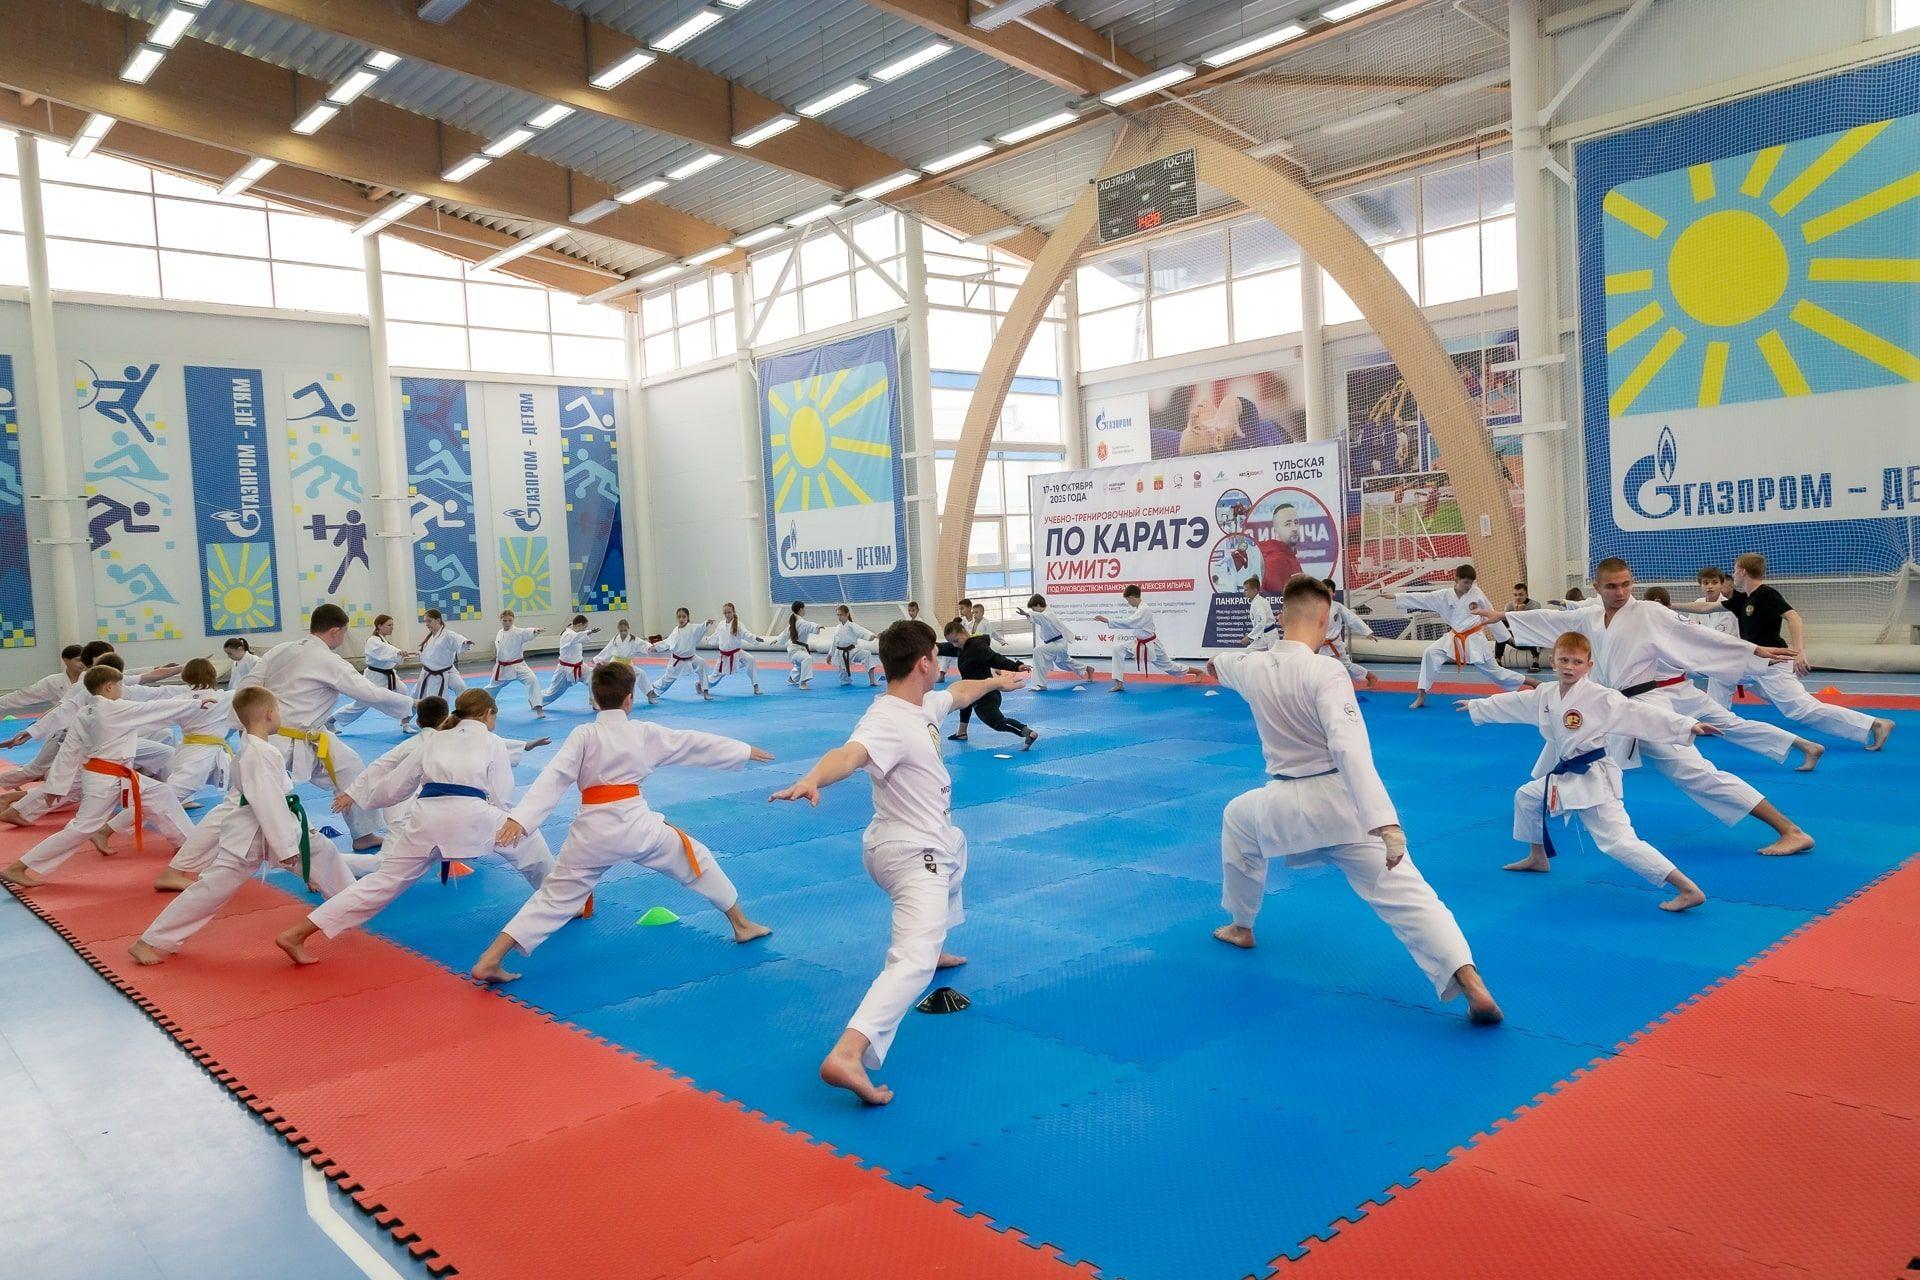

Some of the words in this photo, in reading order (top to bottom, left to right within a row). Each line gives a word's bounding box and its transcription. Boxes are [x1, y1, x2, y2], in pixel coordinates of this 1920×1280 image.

[1163, 152, 1193, 170] ГОСТИ
[1099, 171, 1136, 191] ХОЗЯЕВА
[232, 378, 257, 426] ДЕТЯМ
[519, 393, 538, 435] ДЕТЯМ
[1273, 457, 1325, 471] ТУЛЬСКАЯ
[237, 444, 260, 509] ГАЗПРОМ
[523, 451, 541, 507] ГАЗПРОМ
[1275, 469, 1323, 482] ОБЛАСТЬ
[1043, 484, 1060, 495] 17-19
[1061, 481, 1094, 493] ОКТЯБРЯ
[1683, 473, 1832, 516] ГАЗПРОМ
[1050, 494, 1067, 504] 2025
[1067, 493, 1088, 503] ГОДА
[1044, 507, 1141, 525] УЧЕБНО-ТРЕНИРОВОЧНЫЙ
[1141, 505, 1181, 517] СЕМИНАР
[1046, 526, 1085, 556] ПО
[1093, 516, 1210, 554] КАРАТЭ
[799, 549, 844, 570] ГАЗПРОМ
[856, 545, 892, 570] ДЕТЯМ
[1046, 558, 1121, 581] КУМИТЭ
[1047, 585, 1060, 593] ПОД
[1060, 584, 1104, 593] РУКОВОДСТВОМ
[1104, 583, 1139, 591] ПАНКРАТ
[1141, 582, 1166, 591] АЛЕКСЕЯ
[1166, 581, 1192, 590] ИЛЬИЧА
[1215, 596, 1252, 605] ПАНКРАТО
